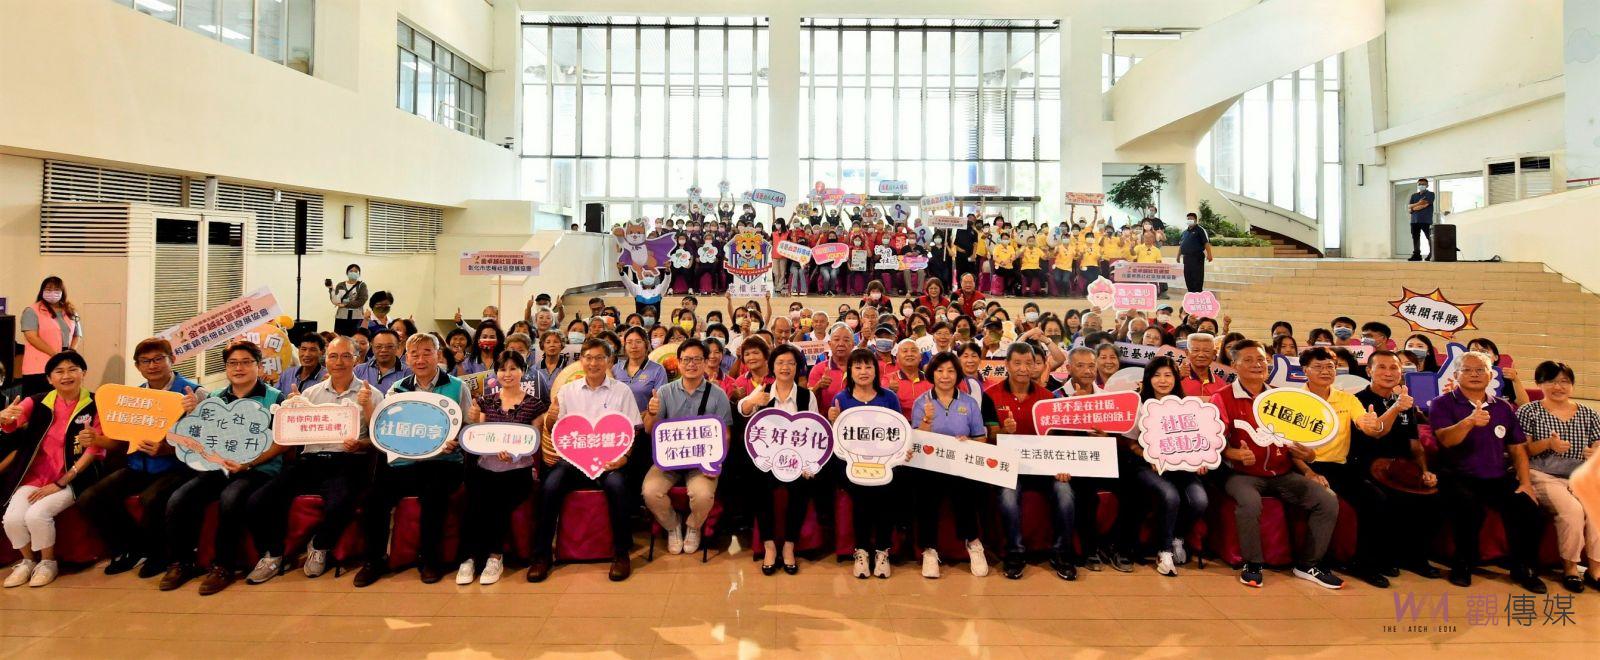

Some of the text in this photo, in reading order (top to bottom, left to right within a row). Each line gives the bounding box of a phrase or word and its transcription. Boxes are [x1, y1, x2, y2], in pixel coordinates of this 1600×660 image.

[188, 304, 254, 339] 金卓越社區選拔
[1404, 303, 1459, 326] 旗開得勝
[201, 408, 262, 435] 彰化社區
[1040, 410, 1134, 426] 就是在去社區的路上
[1160, 414, 1200, 434] 社區
[1262, 400, 1326, 435] 社區創值
[380, 419, 444, 440] 社區同享
[749, 426, 829, 450] 美好彰化
[842, 426, 900, 442] 社區同想
[558, 431, 631, 450] 幸福影響力
[1159, 434, 1211, 455] 感動力
[935, 448, 956, 461] 社區
[965, 453, 986, 466] 社區
[999, 461, 1010, 472] 我
[1019, 448, 1101, 462] 生活就在社區裡
